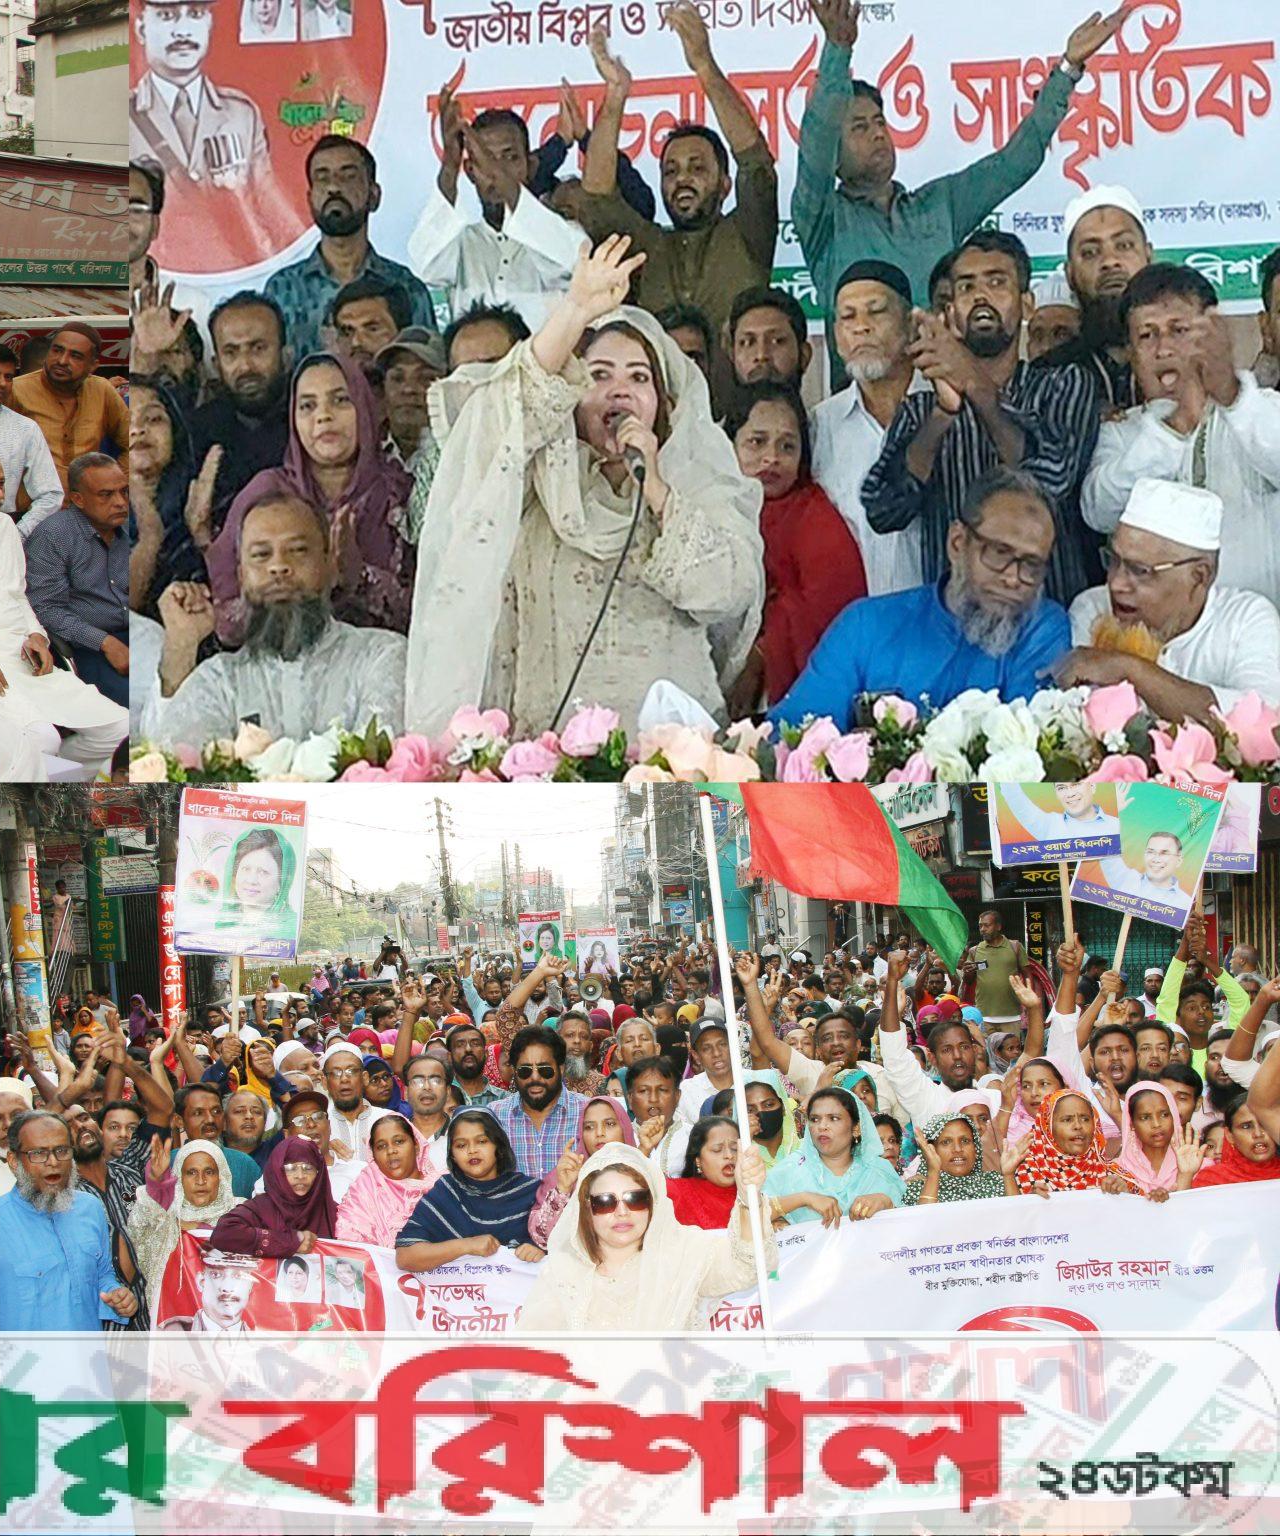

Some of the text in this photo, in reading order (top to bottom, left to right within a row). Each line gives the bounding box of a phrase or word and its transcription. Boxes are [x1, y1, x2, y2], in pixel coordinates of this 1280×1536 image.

[444, 1, 532, 53] জাতীয়
[620, 2, 646, 36] ও
[26, 260, 48, 273] উত্তর
[80, 262, 112, 275] বরিশাল
[188, 803, 220, 817] ধানের
[252, 808, 278, 822] ভোট
[281, 809, 301, 825] দিন
[1012, 837, 1113, 856] ২২নং ওয়ার্ড বিএনপি
[1212, 853, 1250, 864] বিএনপি
[1113, 892, 1138, 907] ওয়ার্ড
[1140, 900, 1177, 917] বিএনপি
[1019, 1232, 1070, 1247] বাংলাদেশের
[943, 1259, 966, 1272] মহান
[969, 1254, 1012, 1269] স্বাধীনতার
[1056, 1258, 1113, 1283] জিয়াউর
[1117, 1258, 1172, 1277] রহমান
[985, 1271, 1006, 1284] শহীদ
[1127, 1278, 1161, 1292] সালাম
[428, 1283, 487, 1302] নভেম্বর
